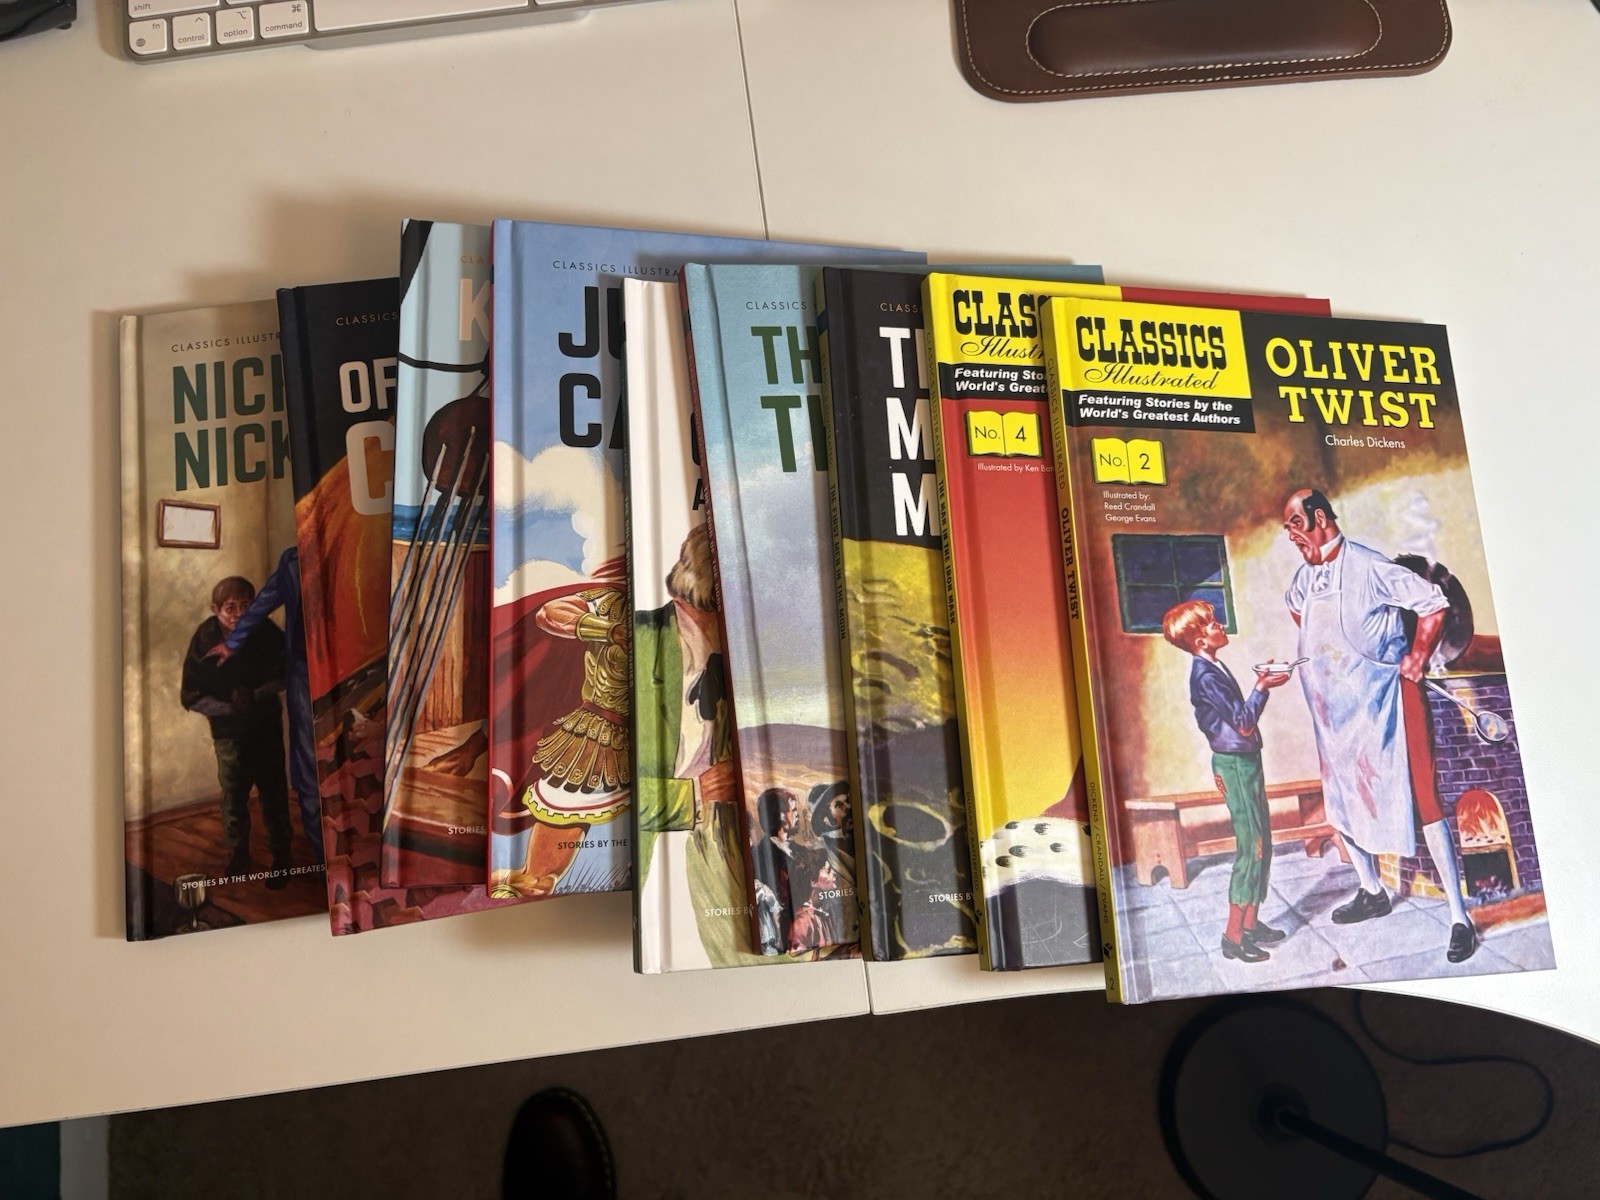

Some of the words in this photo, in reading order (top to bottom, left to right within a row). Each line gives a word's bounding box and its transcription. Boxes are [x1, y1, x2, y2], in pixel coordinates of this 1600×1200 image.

[134, 3, 151, 12] shift
[224, 28, 248, 38] option
[265, 21, 303, 32] command
[178, 34, 205, 44] control
[553, 260, 616, 272] CLASSICS
[746, 301, 807, 310] CLASSICS
[336, 312, 398, 326] CLASSICS
[172, 338, 230, 352] CLASSICS
[1075, 315, 1227, 370] CLASSICS
[1265, 337, 1442, 385] OLIVER
[954, 368, 1018, 382] Featuring
[1084, 363, 1219, 390] Illustrated
[956, 381, 1004, 392] World's
[1047, 358, 1059, 413] CLASSICS
[1078, 394, 1141, 408] Featuring
[1146, 397, 1190, 410] Stories
[1194, 400, 1208, 412] by
[1212, 400, 1232, 412] the
[1278, 386, 1437, 429] TWIST
[1080, 408, 1128, 420] World's
[1133, 410, 1188, 422] Greatest
[1192, 413, 1241, 425] Authors
[974, 426, 1000, 440] No.
[1015, 426, 1026, 442] 4
[1325, 434, 1364, 448] Charles
[1366, 436, 1406, 449] Dickens
[1052, 417, 1066, 490] ILLUSTRATED
[978, 463, 1012, 472] Illustrated
[1014, 464, 1022, 473] by
[1025, 464, 1039, 472] Ken
[1100, 454, 1125, 467] No.
[1140, 453, 1150, 470] 2
[1103, 490, 1138, 499] Illustrated
[1124, 503, 1156, 511] Crandall
[1106, 514, 1134, 524] George
[1136, 514, 1156, 522] Evans
[942, 528, 948, 540] IN
[1060, 507, 1074, 566] OLIVER
[1067, 570, 1080, 619] TWIST
[836, 568, 842, 581] IN
[448, 826, 486, 835] STORIES
[558, 841, 594, 850] STORIES
[598, 840, 609, 848] BY
[612, 838, 628, 847] THE
[1090, 781, 1099, 822] DICKENS
[1095, 832, 1105, 880] CRANDALL
[1101, 892, 1109, 923] EVANS
[182, 878, 216, 890] STORIES
[218, 876, 229, 885] BY
[232, 874, 246, 884] THE
[249, 868, 288, 880] WORLD'S
[818, 888, 854, 900] STORIES
[928, 894, 964, 902] STORIES
[704, 907, 740, 916] STORIES
[1109, 976, 1115, 990] 2
